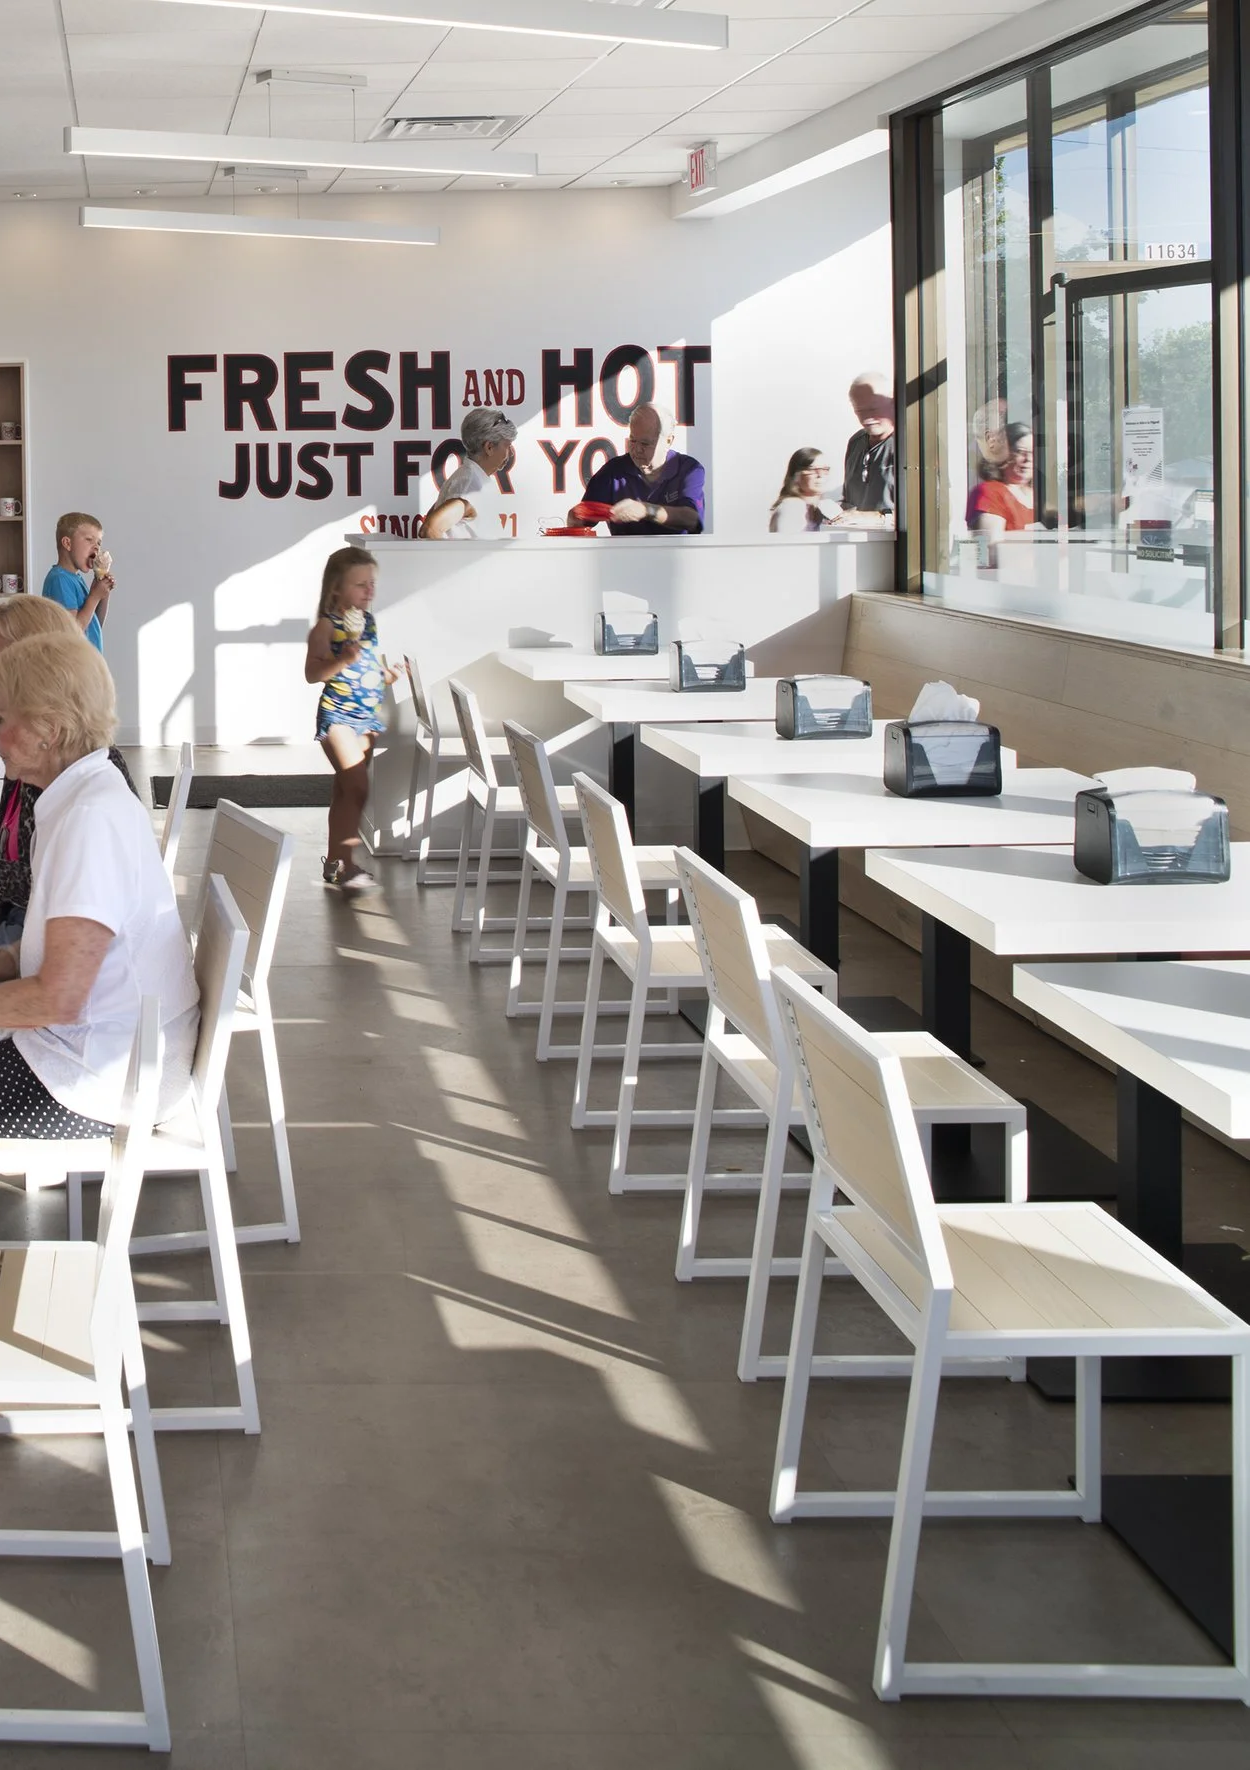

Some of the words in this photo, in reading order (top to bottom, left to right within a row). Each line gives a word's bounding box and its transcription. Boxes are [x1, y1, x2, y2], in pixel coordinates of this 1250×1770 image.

[1147, 244, 1196, 259] 11634
[167, 350, 451, 432] FRESH
[462, 368, 526, 407] AND
[541, 344, 712, 428] HOT
[218, 441, 374, 500] JUST
[537, 436, 630, 495] YO
